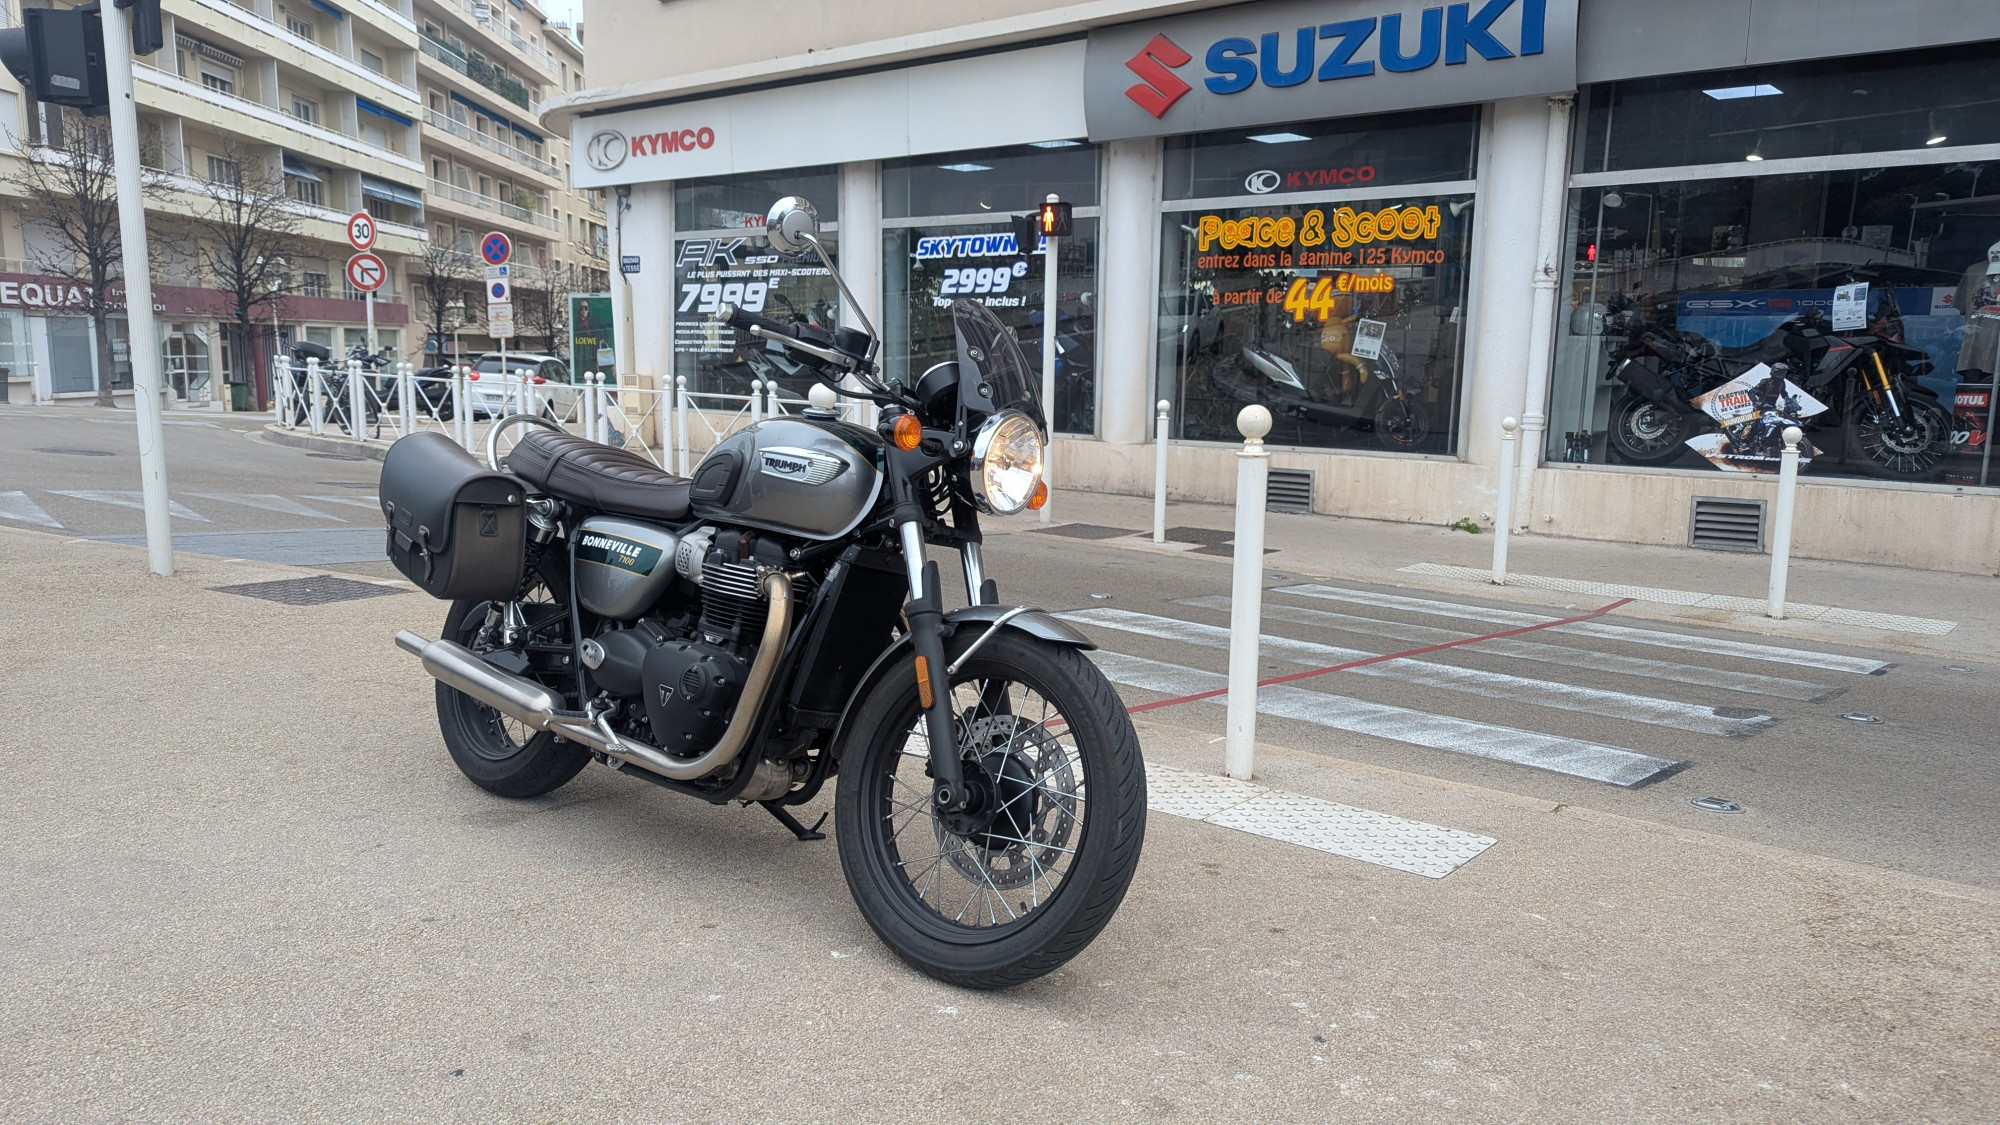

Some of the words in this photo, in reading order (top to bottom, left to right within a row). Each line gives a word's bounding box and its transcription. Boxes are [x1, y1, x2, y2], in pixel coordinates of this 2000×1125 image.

[1203, 0, 1546, 95] SUZUKI
[631, 127, 715, 157] KYMCO
[1286, 165, 1376, 188] KYMCO
[354, 223, 370, 239] 30
[1198, 215, 1295, 251] Peace
[1300, 210, 1325, 247] &
[676, 237, 747, 268] AK
[744, 255, 779, 265] 550
[916, 233, 1019, 259] SKYTOWN
[1198, 255, 1239, 269] entrez
[1243, 251, 1276, 267] dans
[1280, 251, 1292, 267] la
[1299, 251, 1352, 266] gamme
[1359, 248, 1386, 265] 125
[1390, 246, 1445, 265] Kymco
[687, 271, 696, 279] LE
[697, 270, 715, 278] PLUS
[715, 270, 751, 278] PUISSANT
[752, 269, 768, 277] DES
[985, 296, 1019, 307] inclus
[1020, 296, 1026, 307] !
[1224, 288, 1263, 305] partir
[1266, 287, 1283, 304] de
[575, 337, 597, 345] LOEWE
[1719, 394, 1751, 408] TRAIL
[764, 457, 807, 474] TRIUMPH
[582, 535, 642, 558] BONNEVILLE
[618, 554, 635, 566] T100
